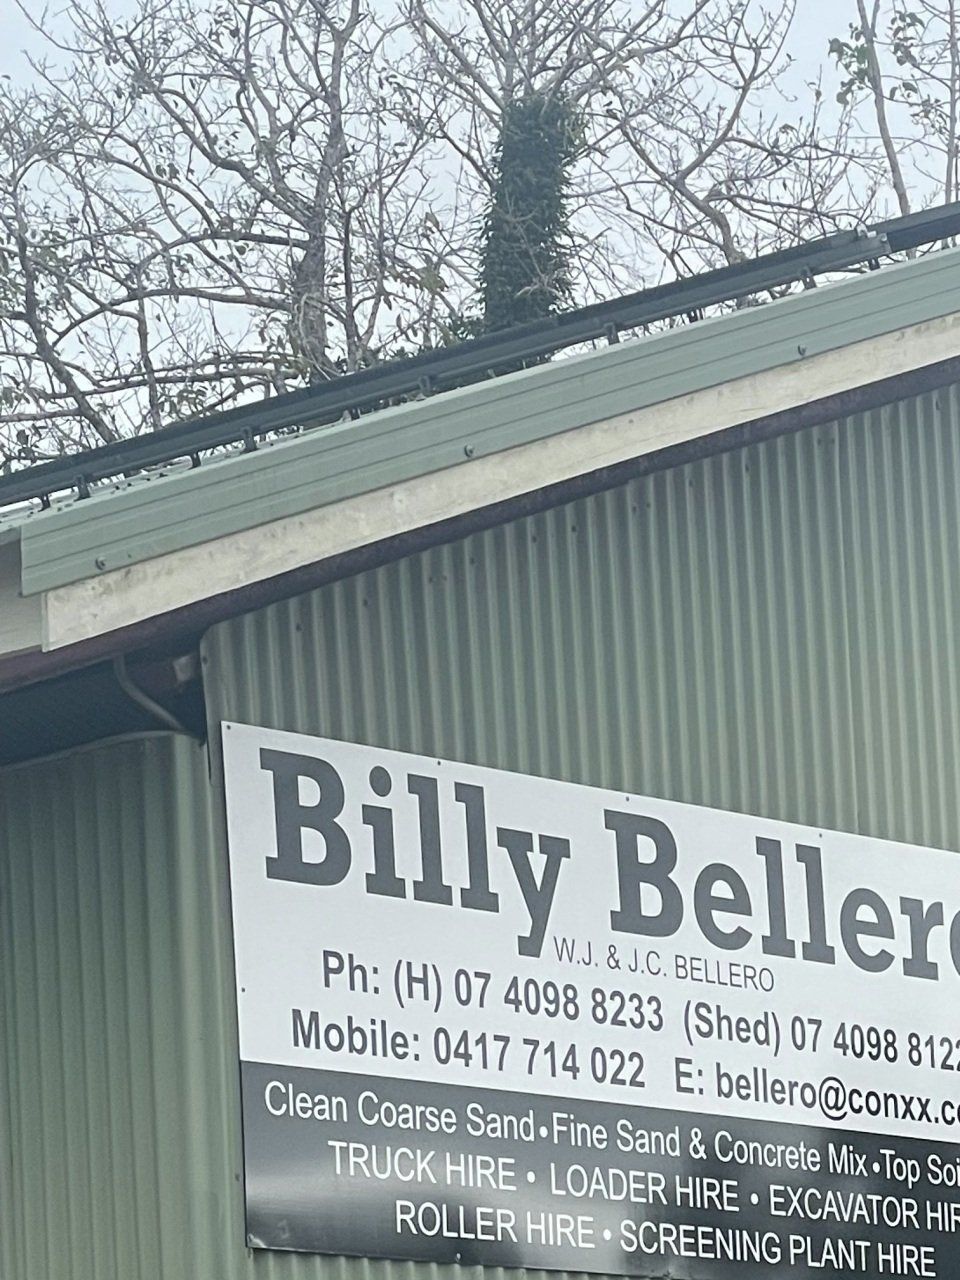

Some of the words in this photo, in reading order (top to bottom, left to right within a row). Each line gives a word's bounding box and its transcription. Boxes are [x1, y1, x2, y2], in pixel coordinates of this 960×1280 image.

[259, 747, 570, 958] Billy
[323, 950, 380, 994] Ph:
[394, 959, 443, 1013] (H)
[454, 968, 492, 1008] 07
[503, 976, 580, 1021] 4098
[591, 987, 664, 1032] 8233
[683, 999, 781, 1057] (Shed)
[791, 1016, 822, 1052] 07
[833, 1022, 898, 1063] 4098
[554, 936, 599, 967] W.J.
[607, 944, 621, 971] &
[628, 948, 668, 977] J.C.
[674, 954, 775, 992] BELLERO
[292, 1008, 420, 1061] Mobile:
[433, 1026, 511, 1072] 0417
[523, 1038, 580, 1080] 714
[590, 1047, 646, 1088] 022
[675, 1057, 704, 1096] E:
[264, 1080, 348, 1123] Clean
[358, 1090, 457, 1133] Coarse
[616, 1118, 680, 1158] Sand
[689, 1130, 707, 1160] &
[714, 1129, 821, 1172] Concrete
[328, 1140, 437, 1184] TRUCK
[446, 1152, 517, 1192] HIRE
[550, 1162, 668, 1206] LOADER
[676, 1175, 740, 1212] HIRE
[769, 1184, 920, 1229] EXCAVATOR
[395, 1200, 517, 1243] ROLLER
[527, 1211, 596, 1249] HIRE
[619, 1219, 781, 1264] SCREENING
[789, 1234, 871, 1272] PLANT
[878, 1243, 937, 1278] HIRE
